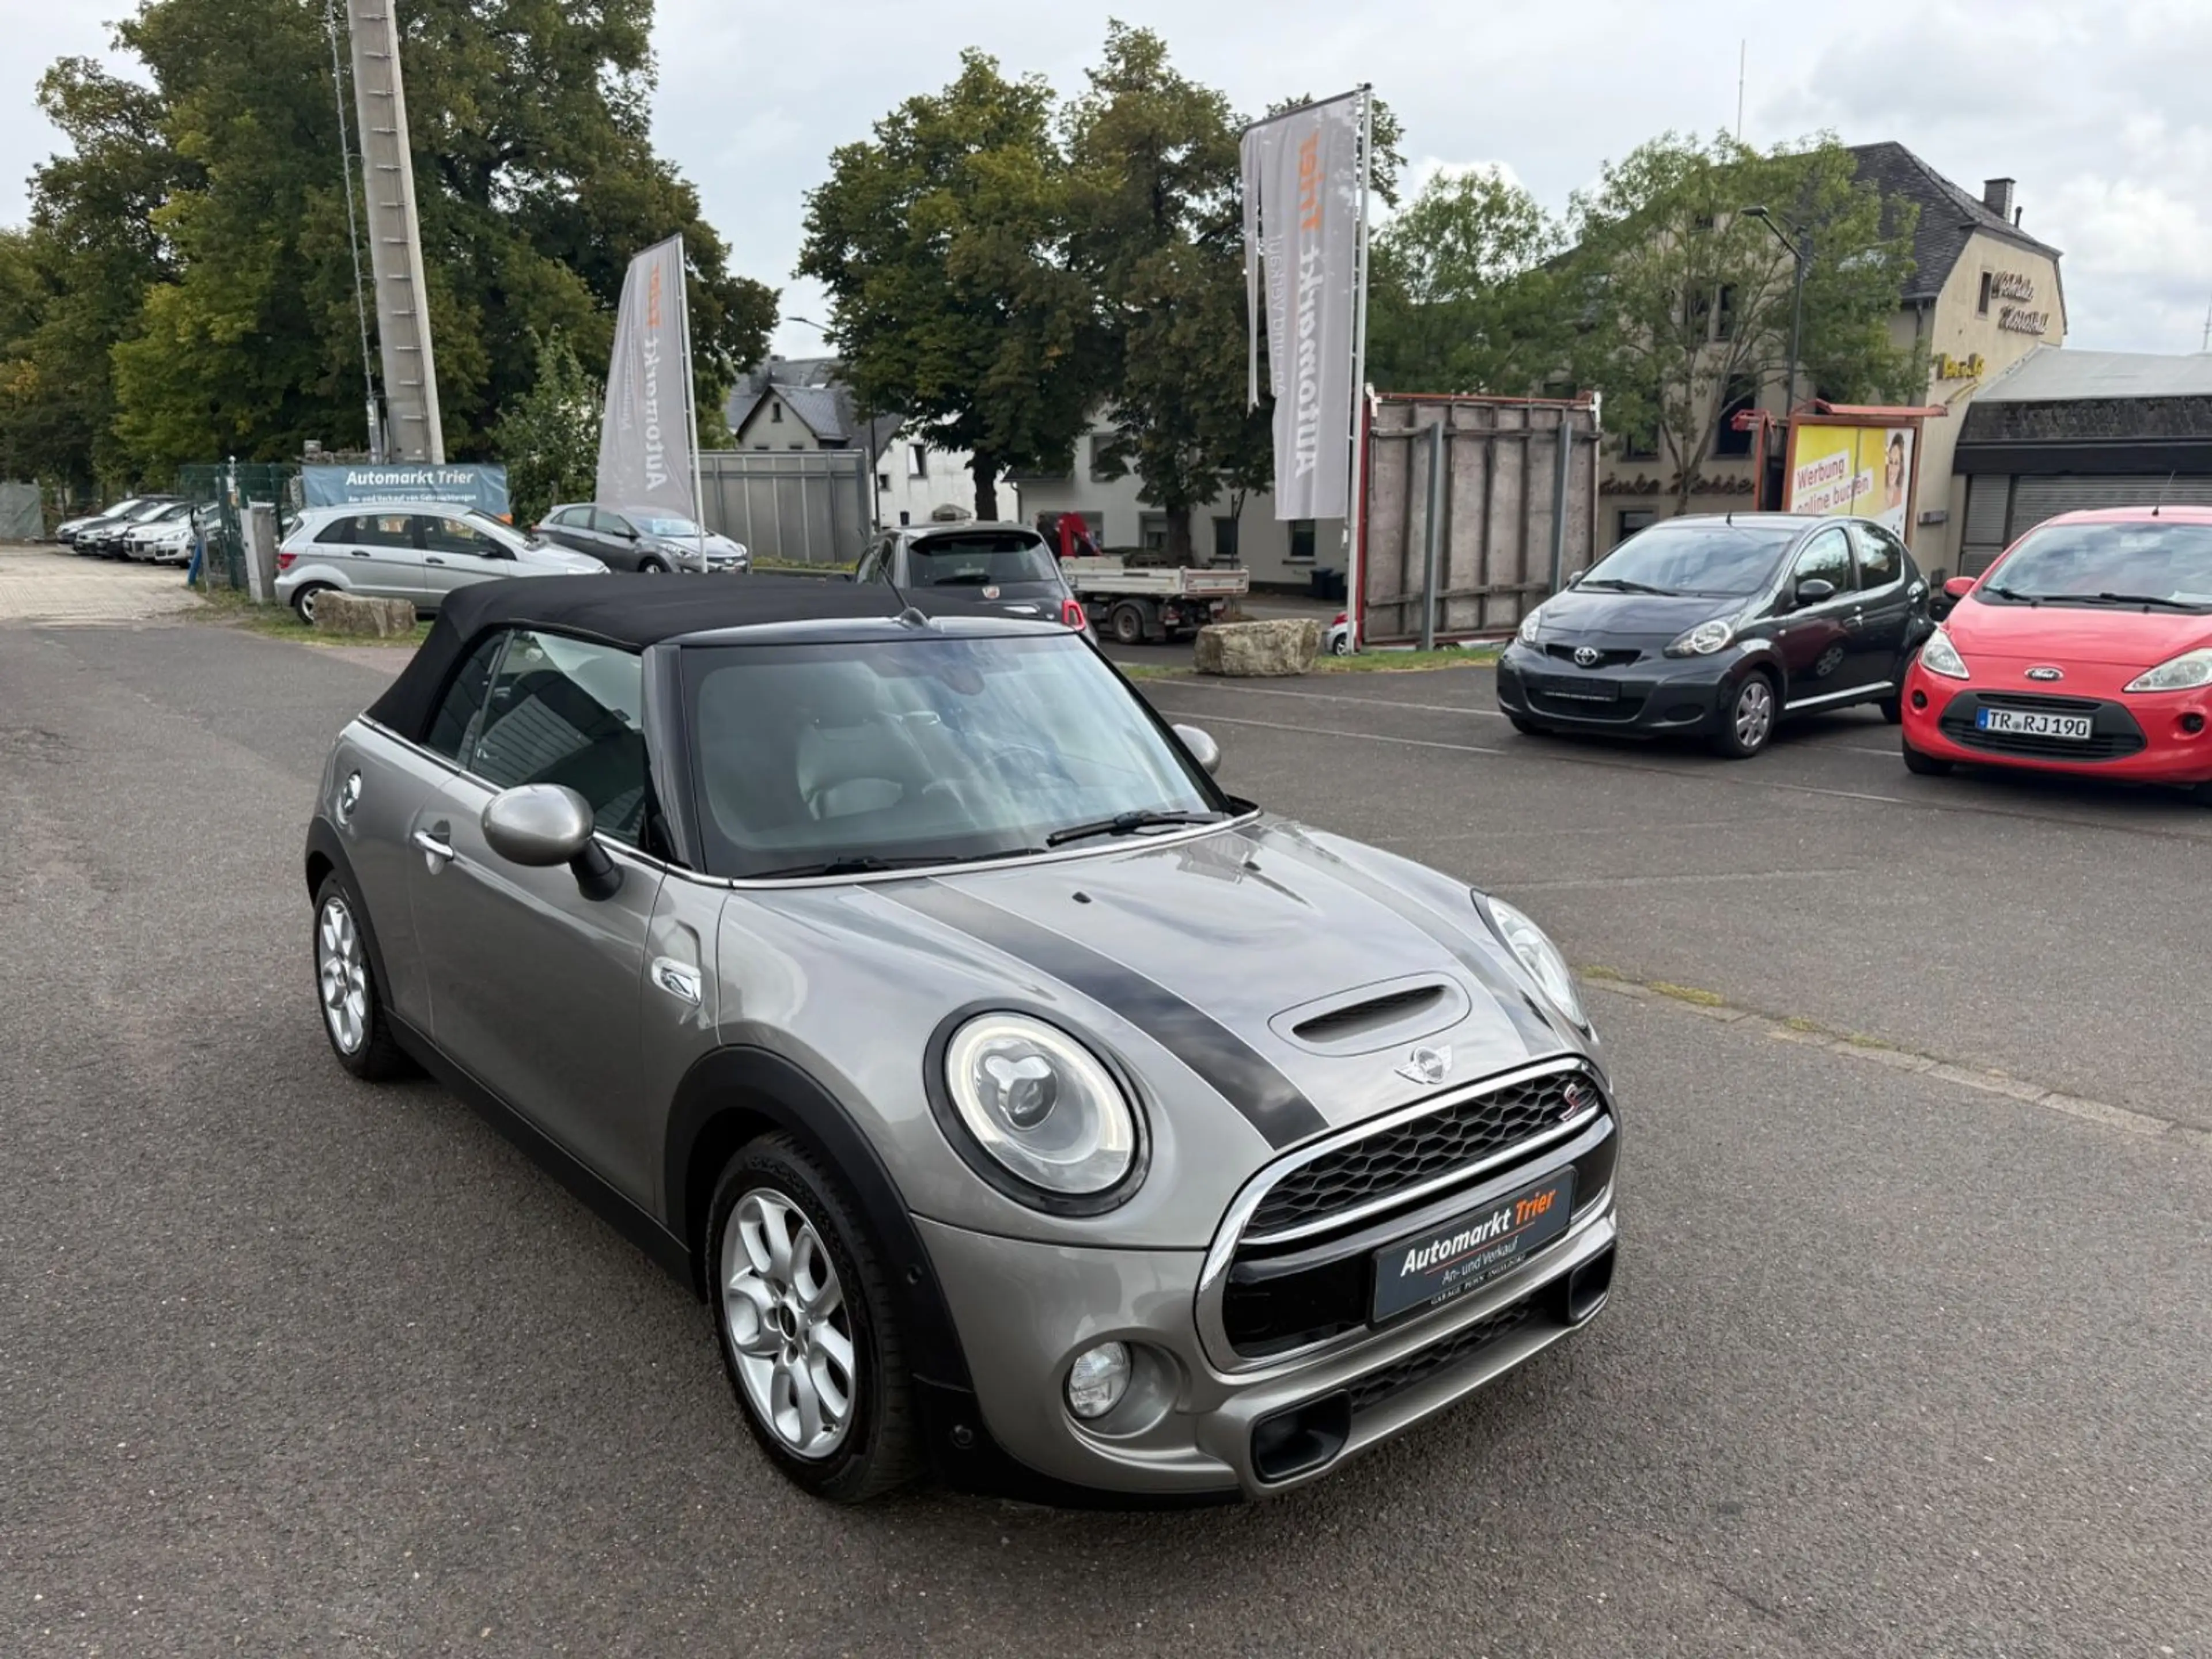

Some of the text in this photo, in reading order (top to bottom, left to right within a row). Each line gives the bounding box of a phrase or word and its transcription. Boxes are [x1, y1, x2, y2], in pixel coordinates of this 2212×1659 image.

[346, 469, 475, 486] Automarkt Trier
[1797, 458, 1846, 490] Werbung
[1796, 493, 1830, 514] online
[1990, 711, 2012, 729] TR
[2051, 718, 2087, 736] 190
[1400, 1208, 1512, 1278] Automarkt
[1516, 1188, 1556, 1225] Trier
[1442, 1269, 1460, 1285] An-
[1461, 1253, 1482, 1275] und
[1482, 1234, 1519, 1265] Verkauf
